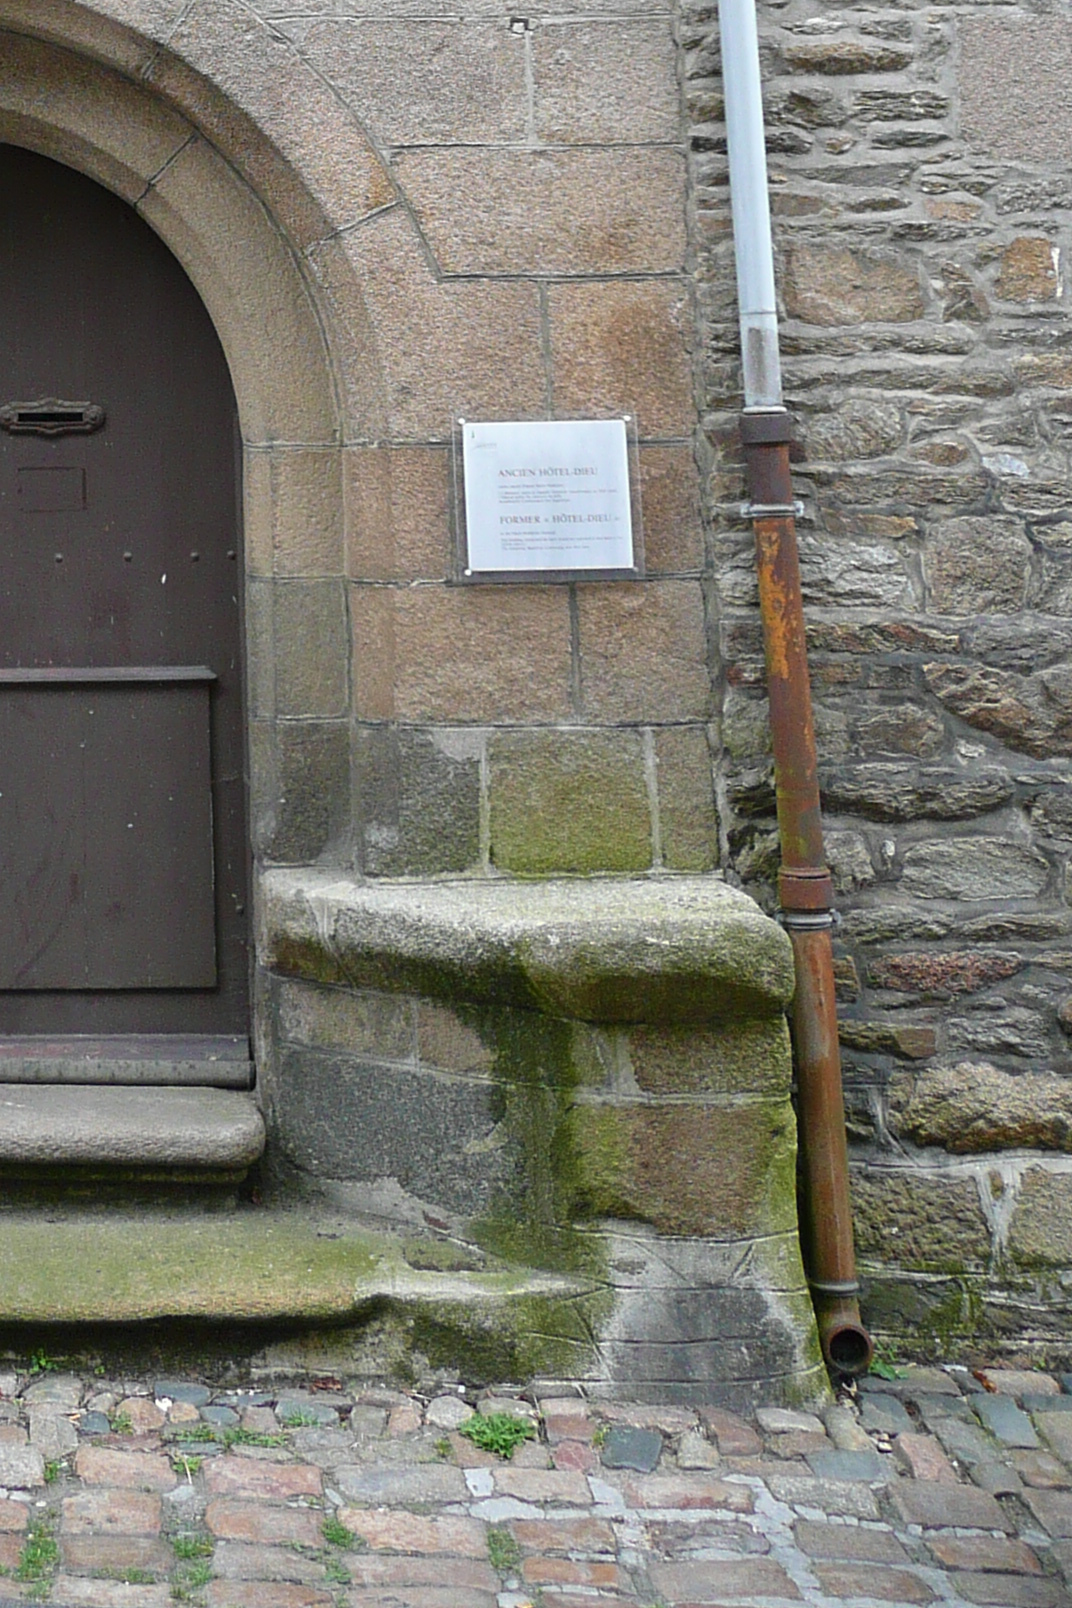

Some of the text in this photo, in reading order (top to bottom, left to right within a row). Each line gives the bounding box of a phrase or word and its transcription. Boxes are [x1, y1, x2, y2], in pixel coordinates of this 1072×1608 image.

[498, 466, 598, 477] ANCIEN HÔTEL-DIEU
[499, 515, 541, 525] FORMER
[552, 513, 612, 524] HÔTEL-DIEU
